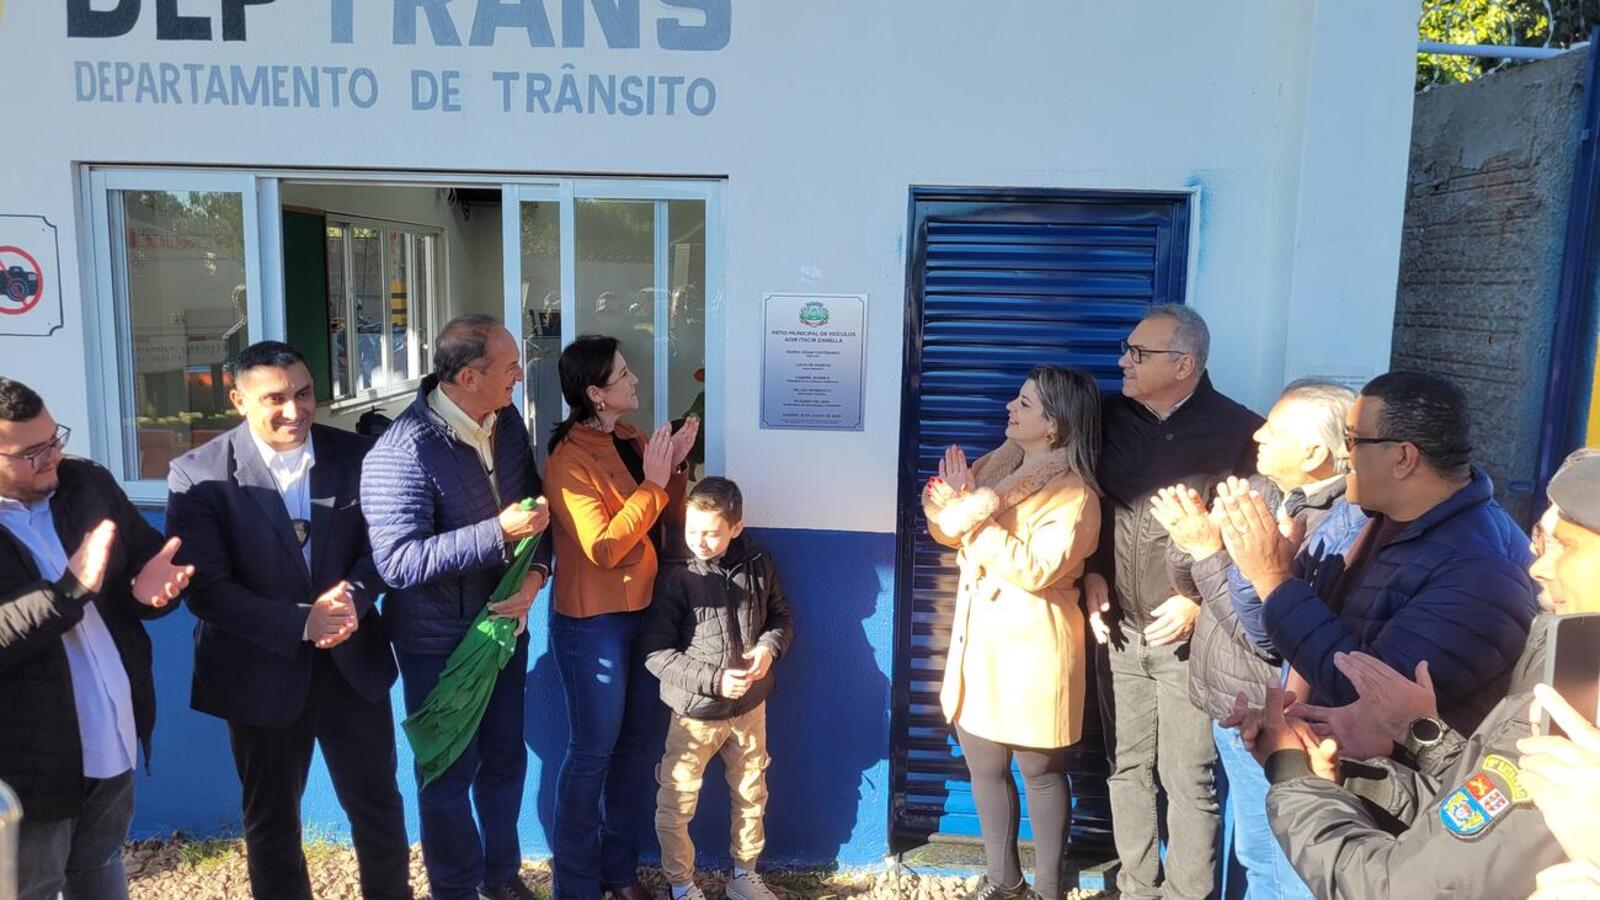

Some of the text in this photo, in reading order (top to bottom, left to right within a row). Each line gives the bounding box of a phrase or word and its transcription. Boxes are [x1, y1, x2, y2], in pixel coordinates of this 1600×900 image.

[74, 60, 717, 116] DEPARTAMENTO DE TRÂNSITO
